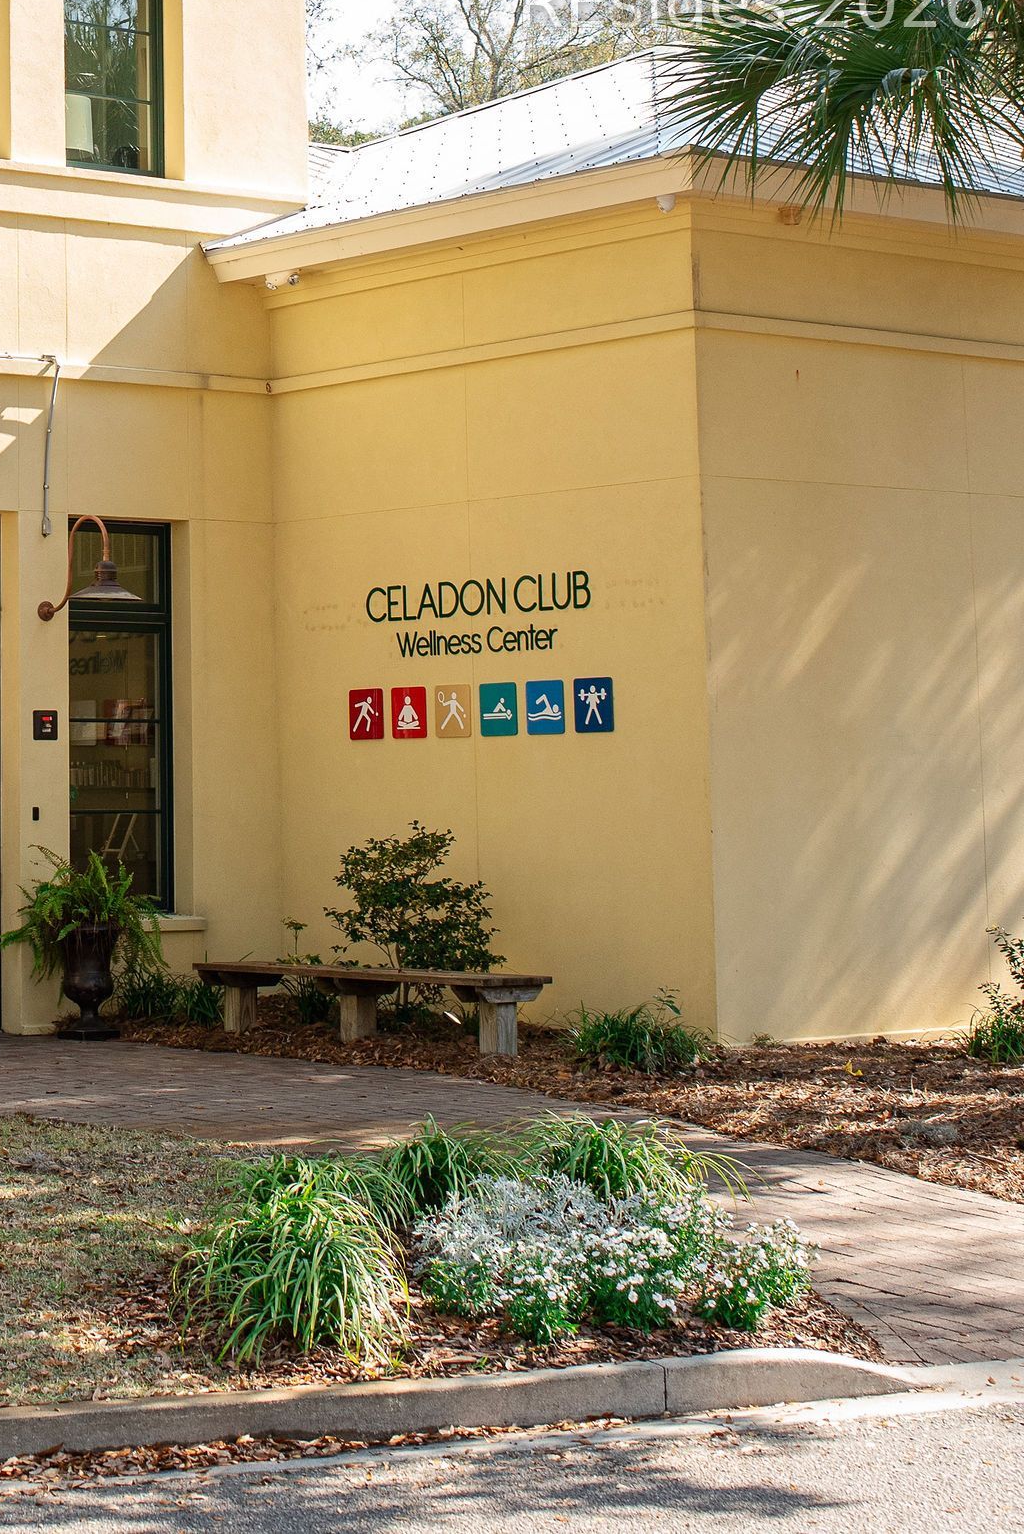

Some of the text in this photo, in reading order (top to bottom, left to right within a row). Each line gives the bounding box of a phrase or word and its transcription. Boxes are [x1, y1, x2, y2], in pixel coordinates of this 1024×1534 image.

[366, 570, 592, 623] CELADON CLUB
[396, 623, 559, 658] Wellness Center
